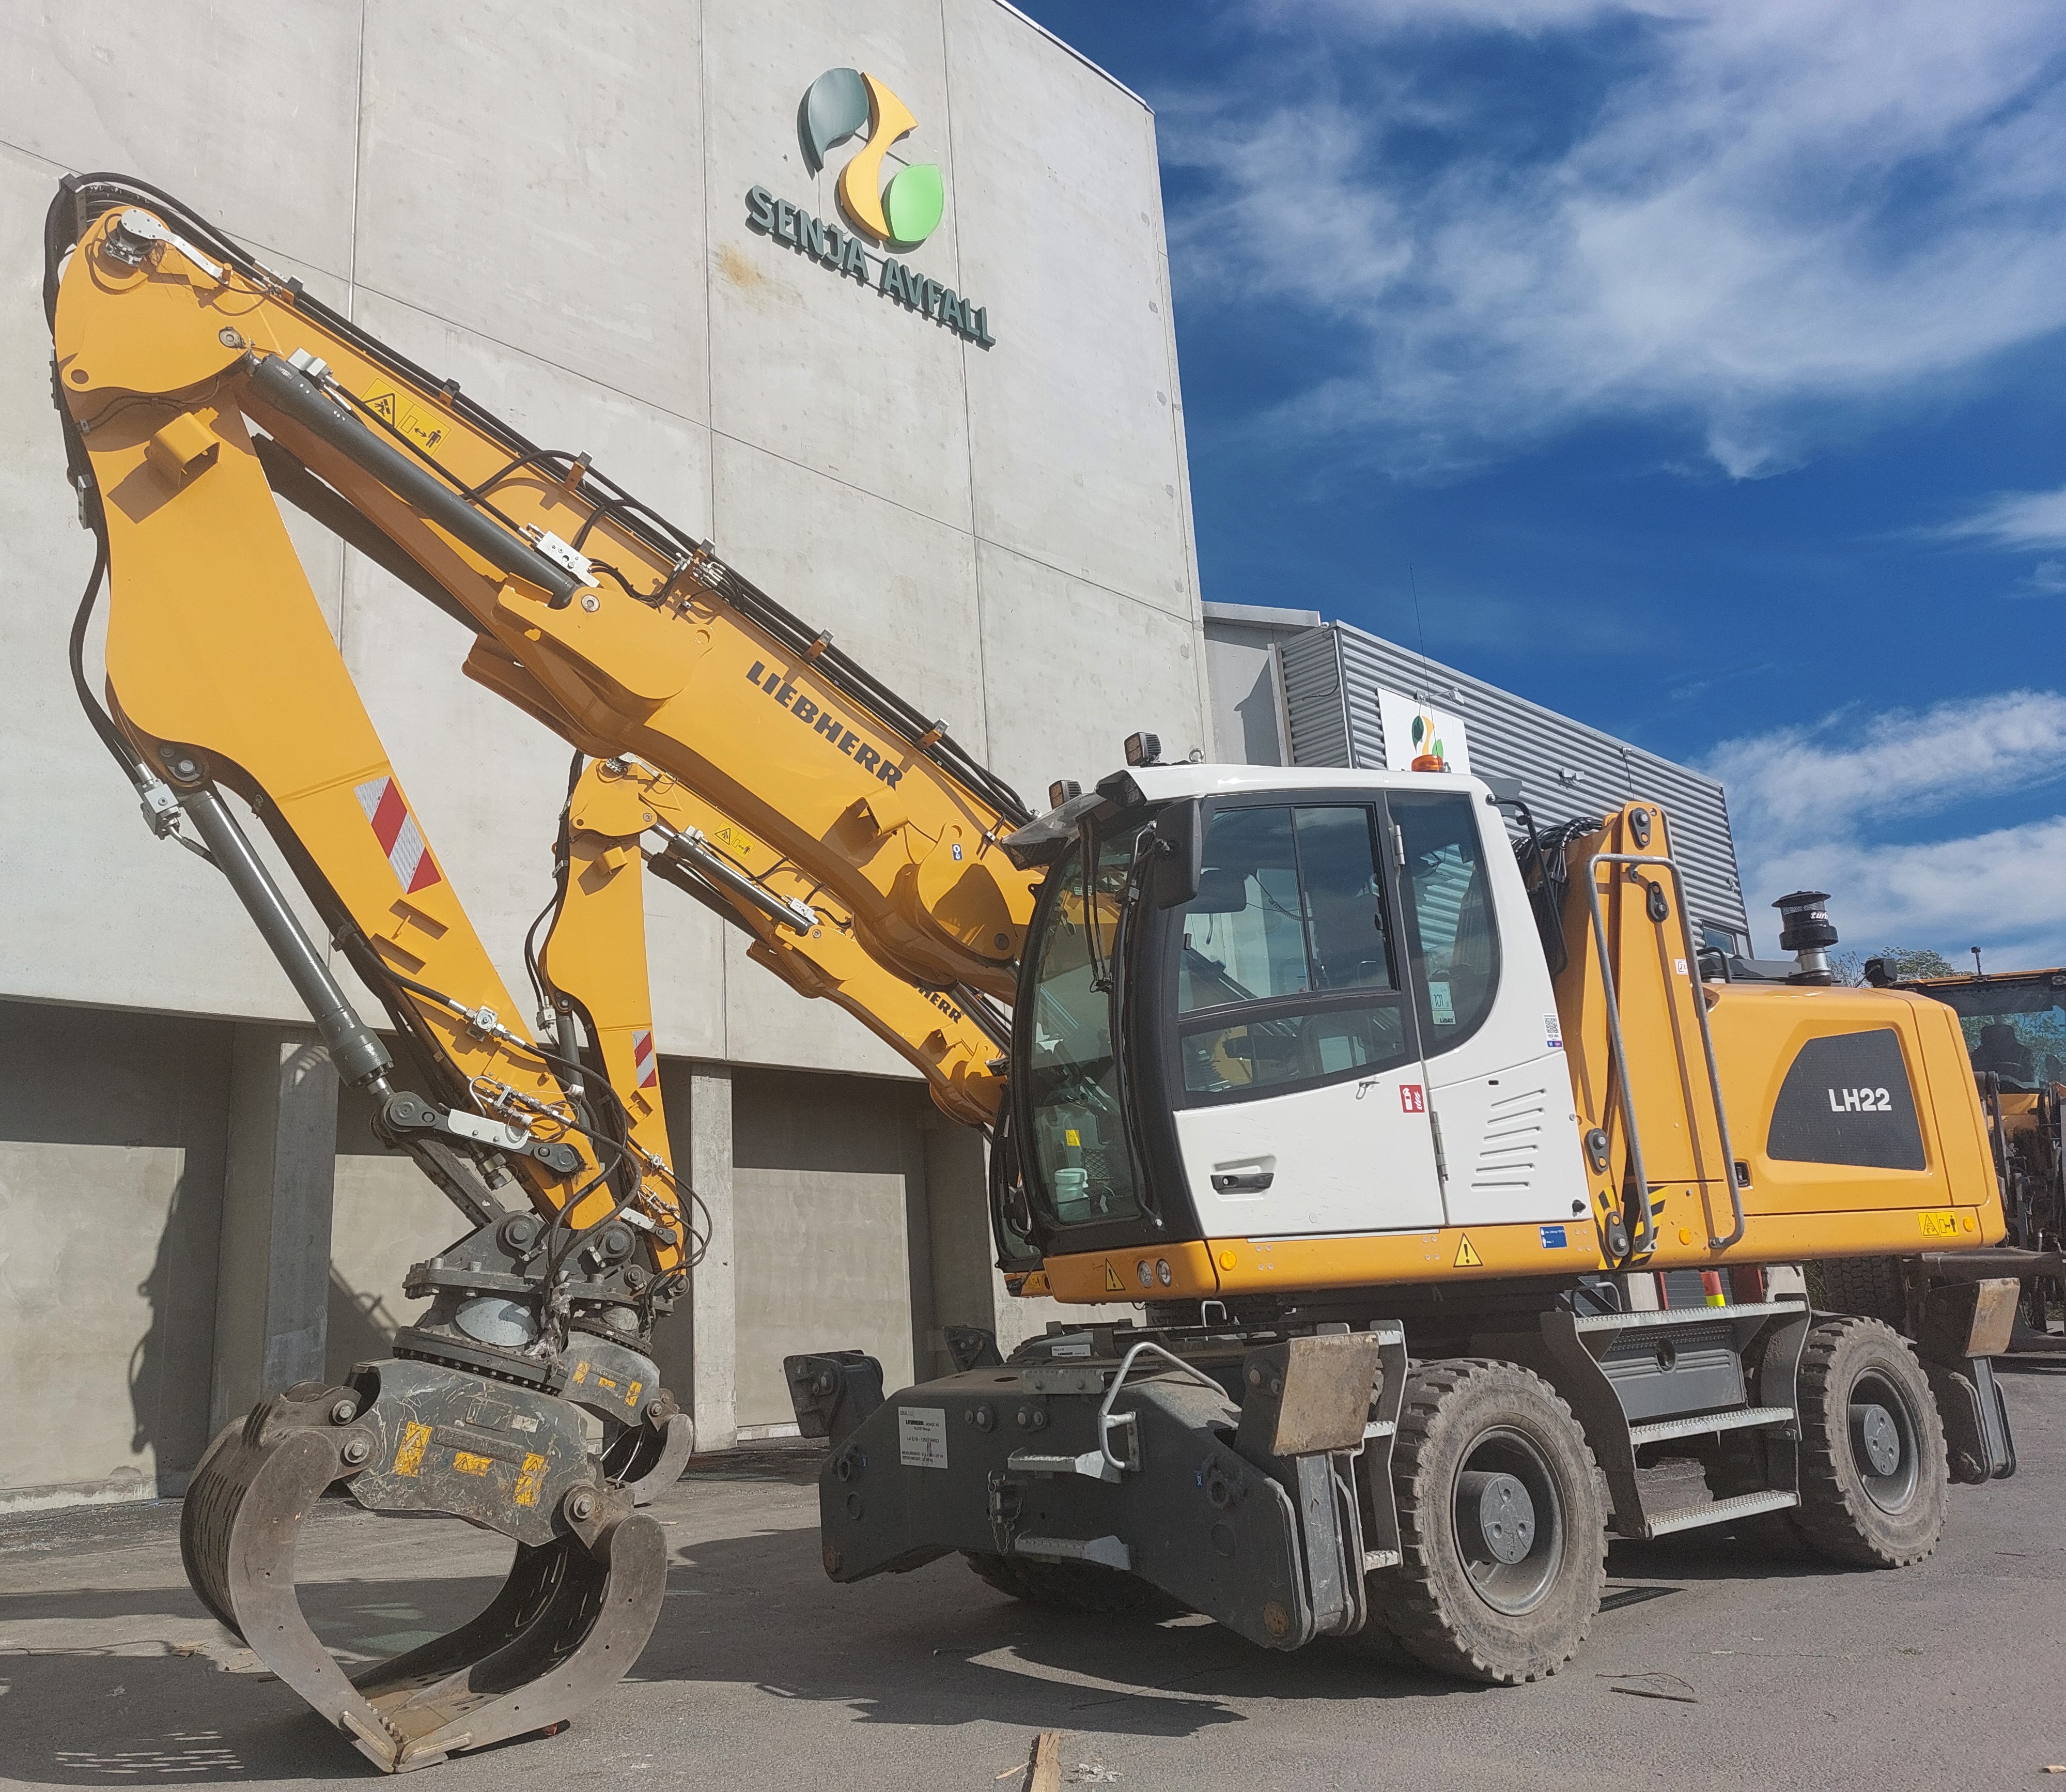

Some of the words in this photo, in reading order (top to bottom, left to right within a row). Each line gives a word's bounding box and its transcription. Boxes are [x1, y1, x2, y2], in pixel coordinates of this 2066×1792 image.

[745, 185, 870, 285] SENJA
[879, 257, 996, 352] AVFALL
[745, 660, 903, 791] LIEBHERR
[1434, 994, 1444, 1007] 101
[1828, 1088, 1892, 1111] LH22
